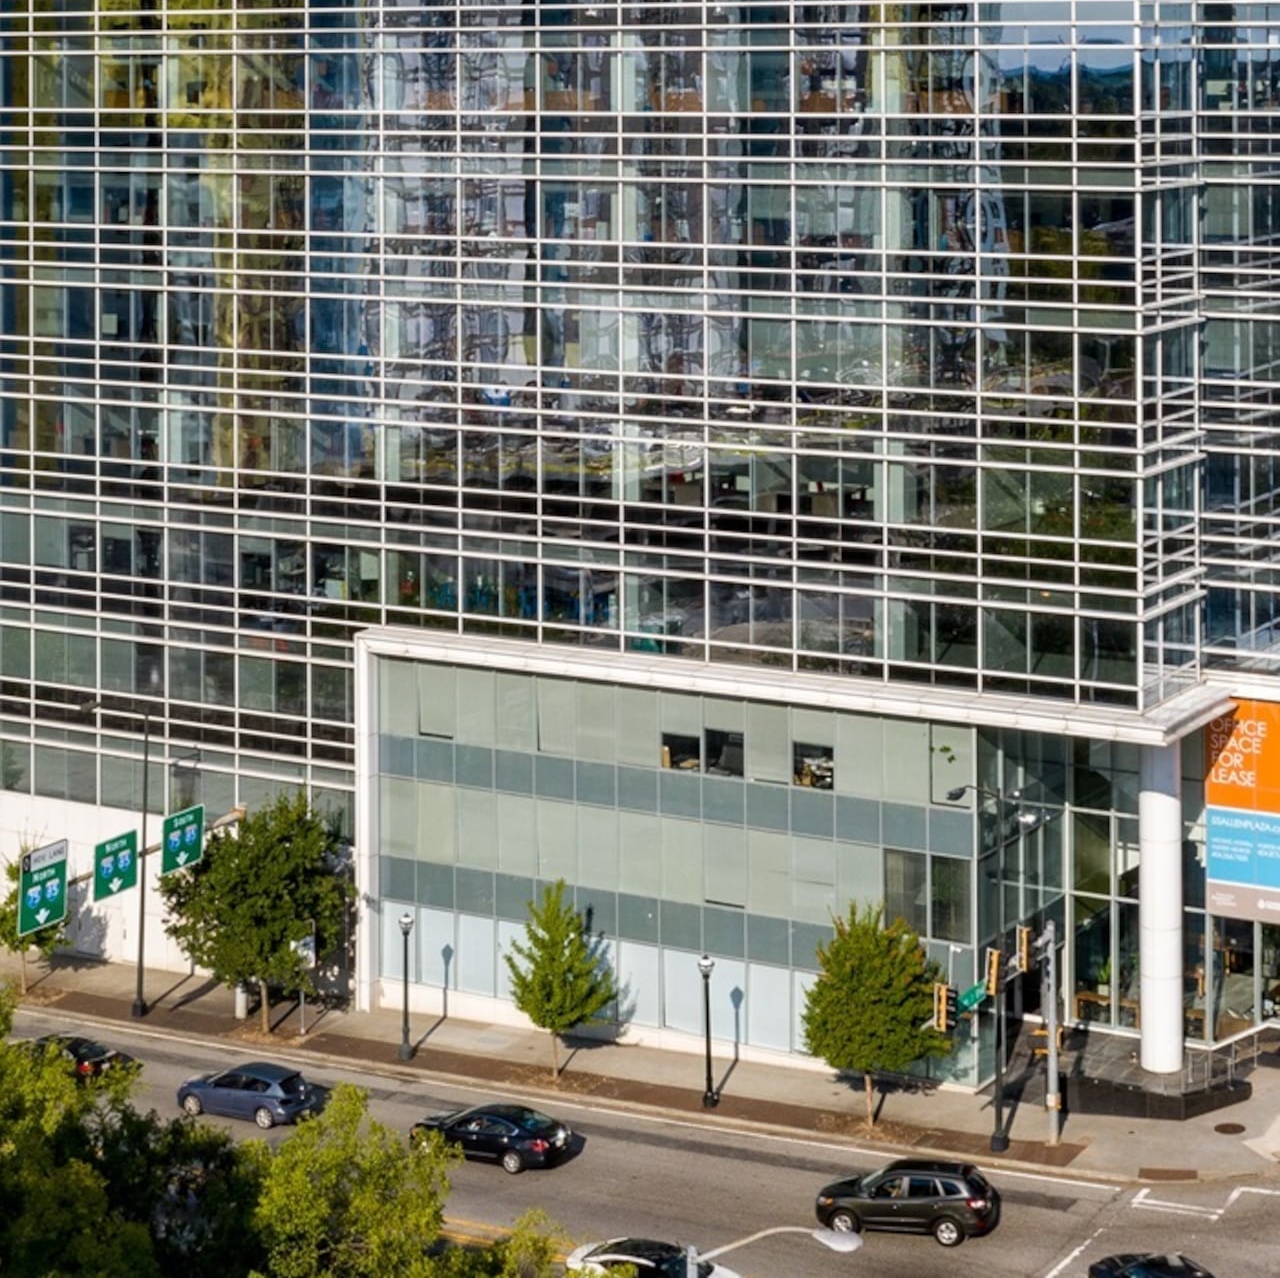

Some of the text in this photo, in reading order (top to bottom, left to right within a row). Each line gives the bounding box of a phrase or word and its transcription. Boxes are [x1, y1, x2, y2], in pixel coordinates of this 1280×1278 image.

[1210, 717, 1267, 738] OFFICE
[1211, 734, 1262, 755] SPACE
[1211, 750, 1244, 769] FOR
[1211, 767, 1256, 787] LEASE
[49, 846, 65, 860] LANE
